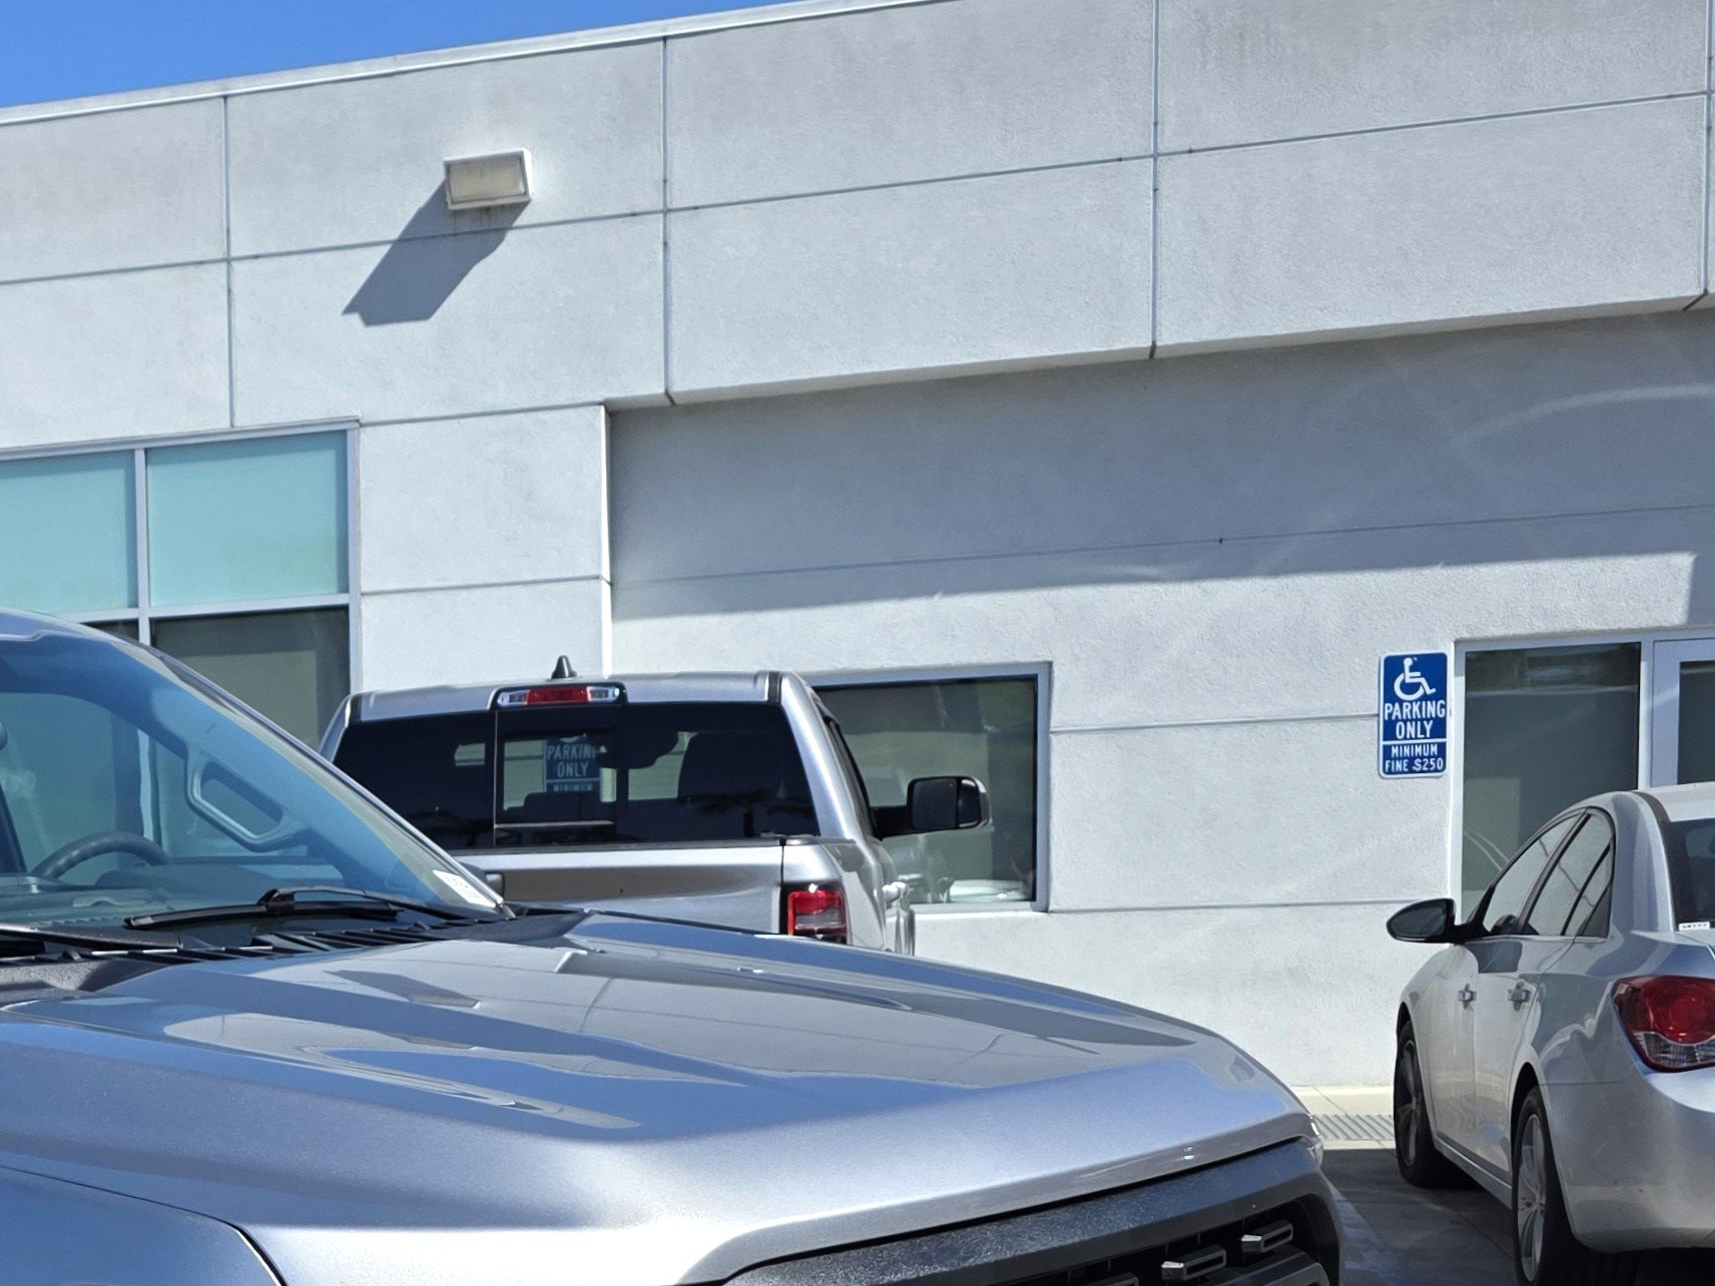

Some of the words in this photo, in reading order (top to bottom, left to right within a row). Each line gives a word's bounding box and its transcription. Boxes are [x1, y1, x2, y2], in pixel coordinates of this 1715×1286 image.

[1384, 701, 1446, 720] PARKING
[1395, 720, 1434, 739] ONLY
[1390, 743, 1438, 758] MINIMUM
[557, 761, 589, 778] ONLY
[1384, 759, 1409, 772] FINE
